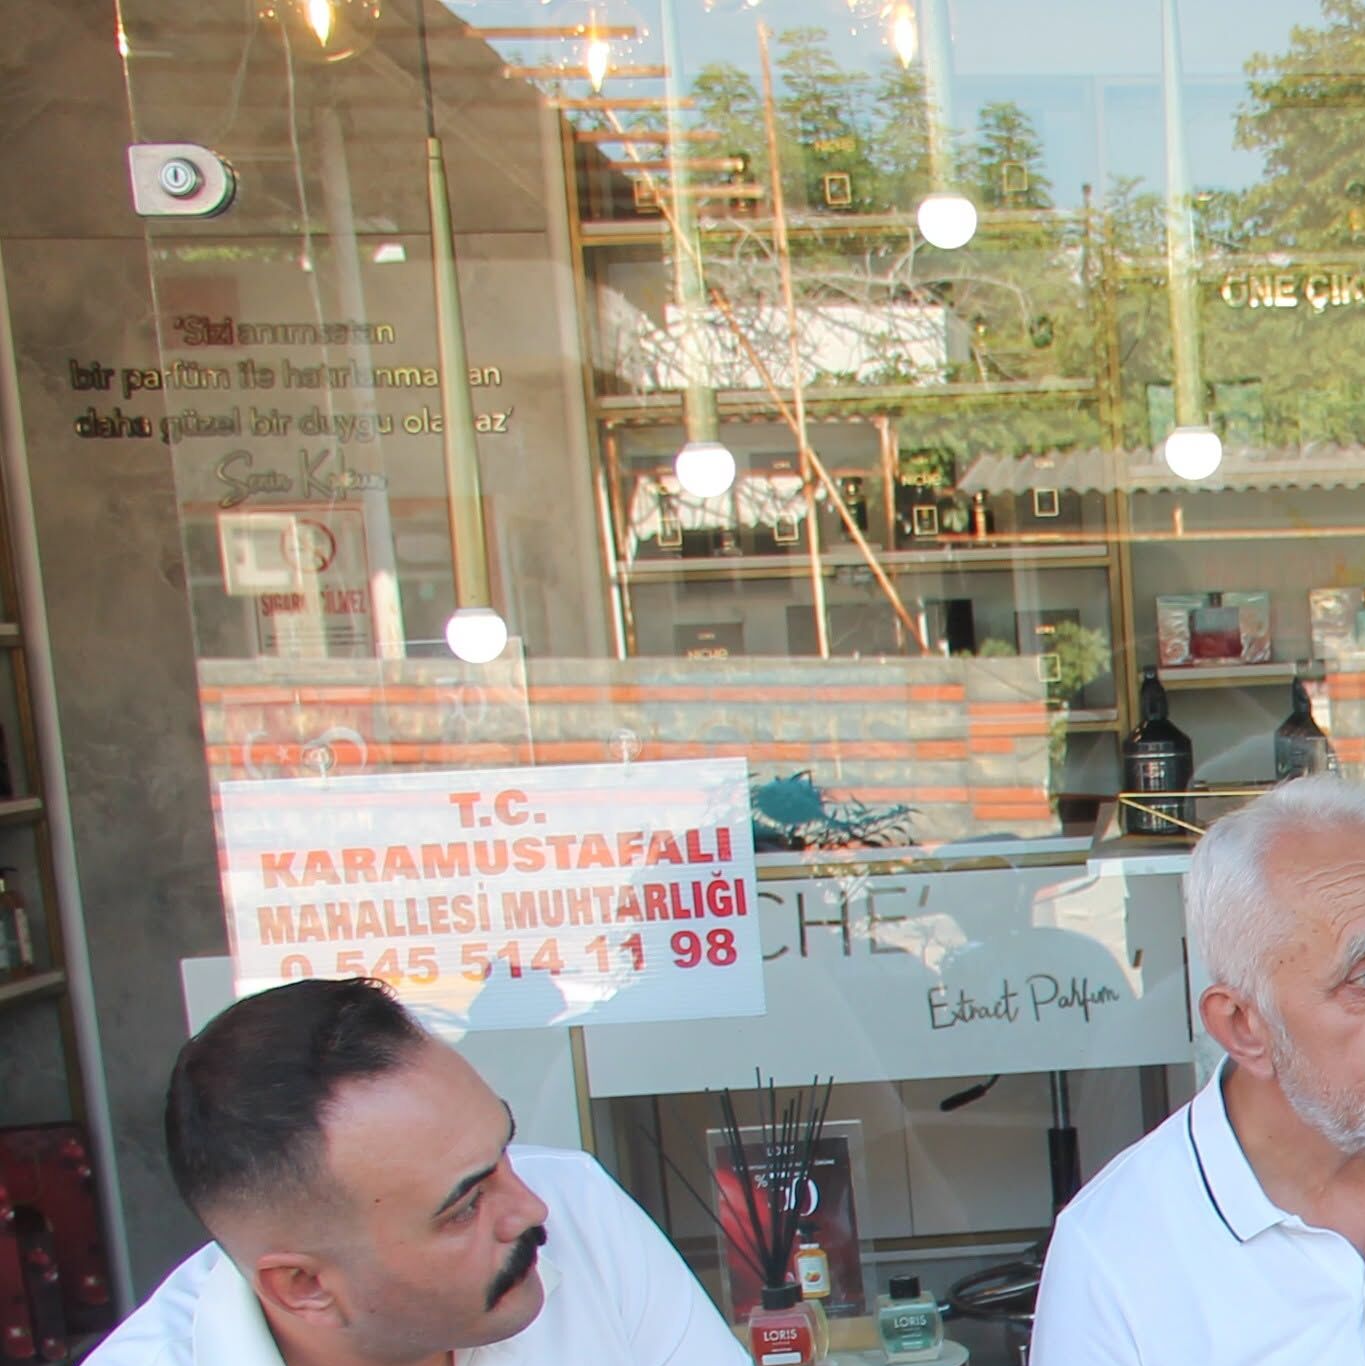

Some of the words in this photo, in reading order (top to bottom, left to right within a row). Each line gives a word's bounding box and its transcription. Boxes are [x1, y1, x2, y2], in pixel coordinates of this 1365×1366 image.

[68, 358, 116, 390] bir
[120, 358, 230, 399] parfüm
[282, 356, 503, 389] hatırlanmaan
[250, 405, 293, 437] bir
[449, 788, 547, 829] T.C.
[260, 826, 733, 889] KARAMUSTAFALI
[256, 881, 492, 946] MAHALLESİ
[502, 869, 749, 930] MUHTARLIĞI
[336, 946, 440, 984] 545
[461, 938, 565, 982] 514
[585, 933, 646, 974] 11
[670, 928, 738, 969] 98
[927, 978, 1019, 1030] Extract
[762, 1328, 798, 1342] LORIS
[893, 1314, 928, 1329] LORIS
